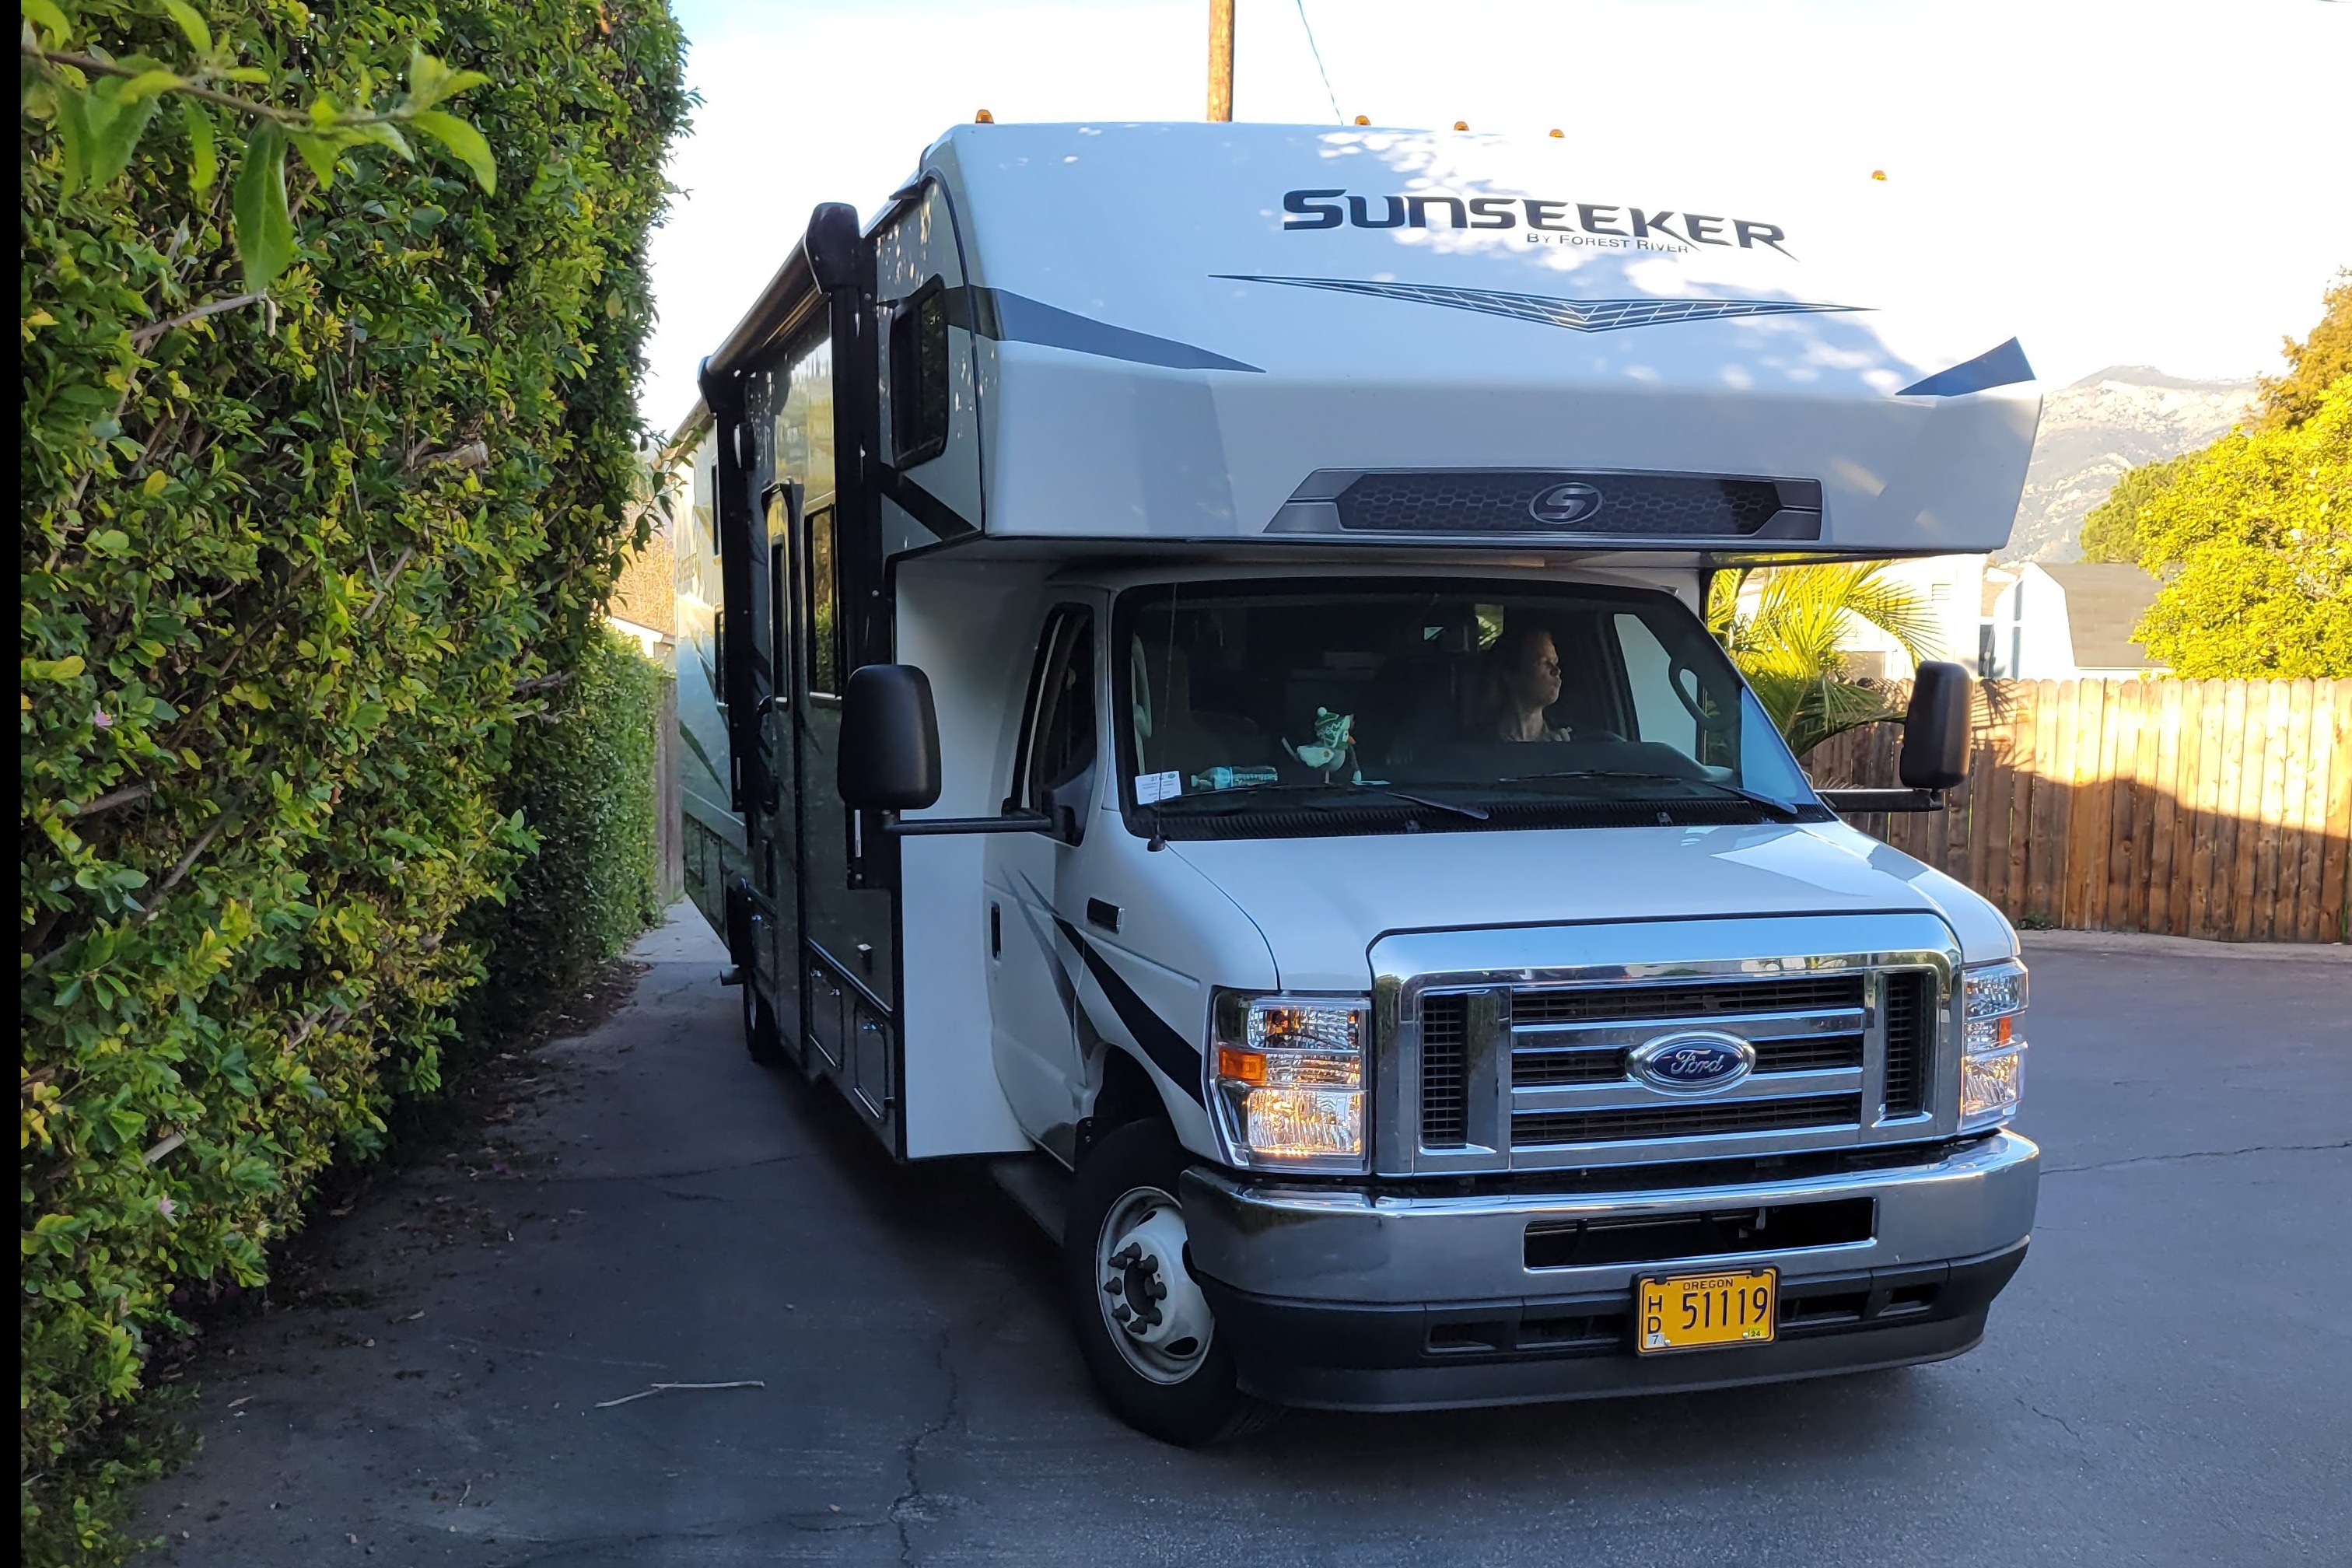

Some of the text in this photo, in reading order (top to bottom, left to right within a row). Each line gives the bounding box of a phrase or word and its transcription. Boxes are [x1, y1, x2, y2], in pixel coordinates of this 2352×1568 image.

[1283, 189, 1800, 262] SUNSEEKER
[1559, 234, 1630, 248] FOREST
[1636, 240, 1689, 254] RIVER
[1671, 1049, 1725, 1075] Ford
[1683, 1278, 1734, 1290] OREGON
[1682, 1286, 1769, 1329] 51119
